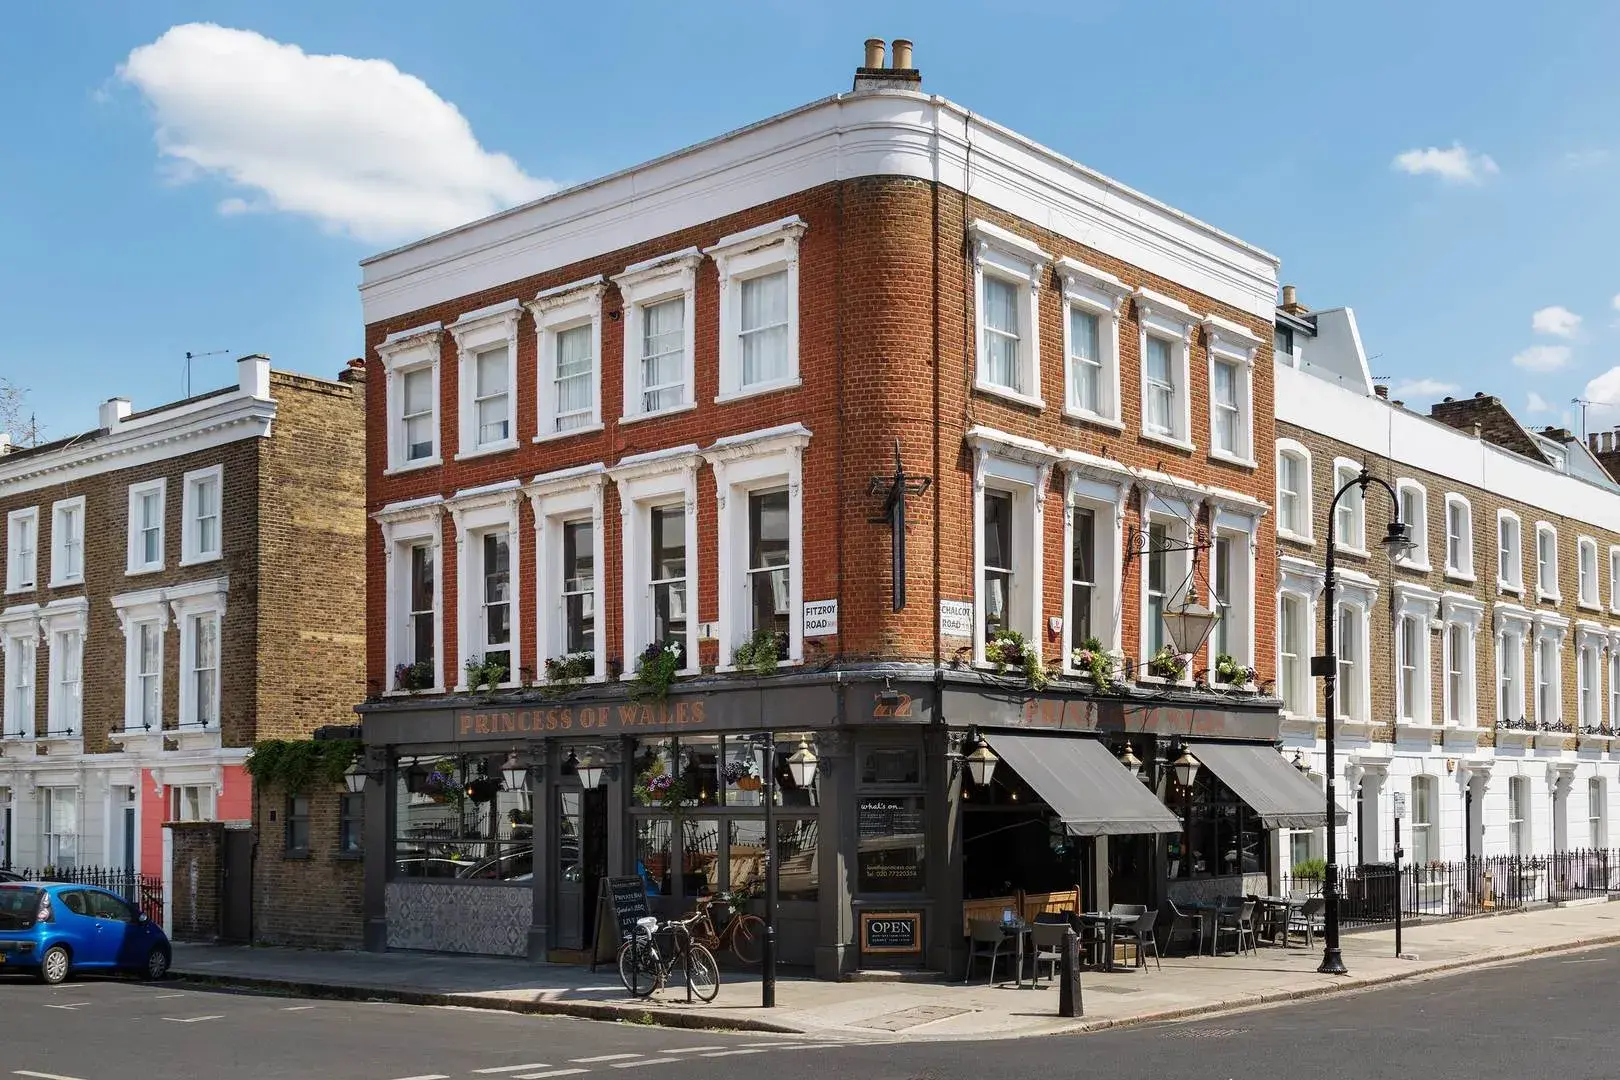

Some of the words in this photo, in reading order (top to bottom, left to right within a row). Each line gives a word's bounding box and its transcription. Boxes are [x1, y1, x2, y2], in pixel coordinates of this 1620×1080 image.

[806, 605, 835, 616] FITZROY
[941, 606, 971, 616] CHALCOT
[806, 619, 827, 630] ROAD
[942, 618, 961, 628] ROAD
[460, 708, 572, 734] PRINCESS
[580, 706, 610, 728] OF
[617, 702, 705, 726] WALES
[860, 802, 886, 811] what's
[871, 921, 911, 933] OPEN
